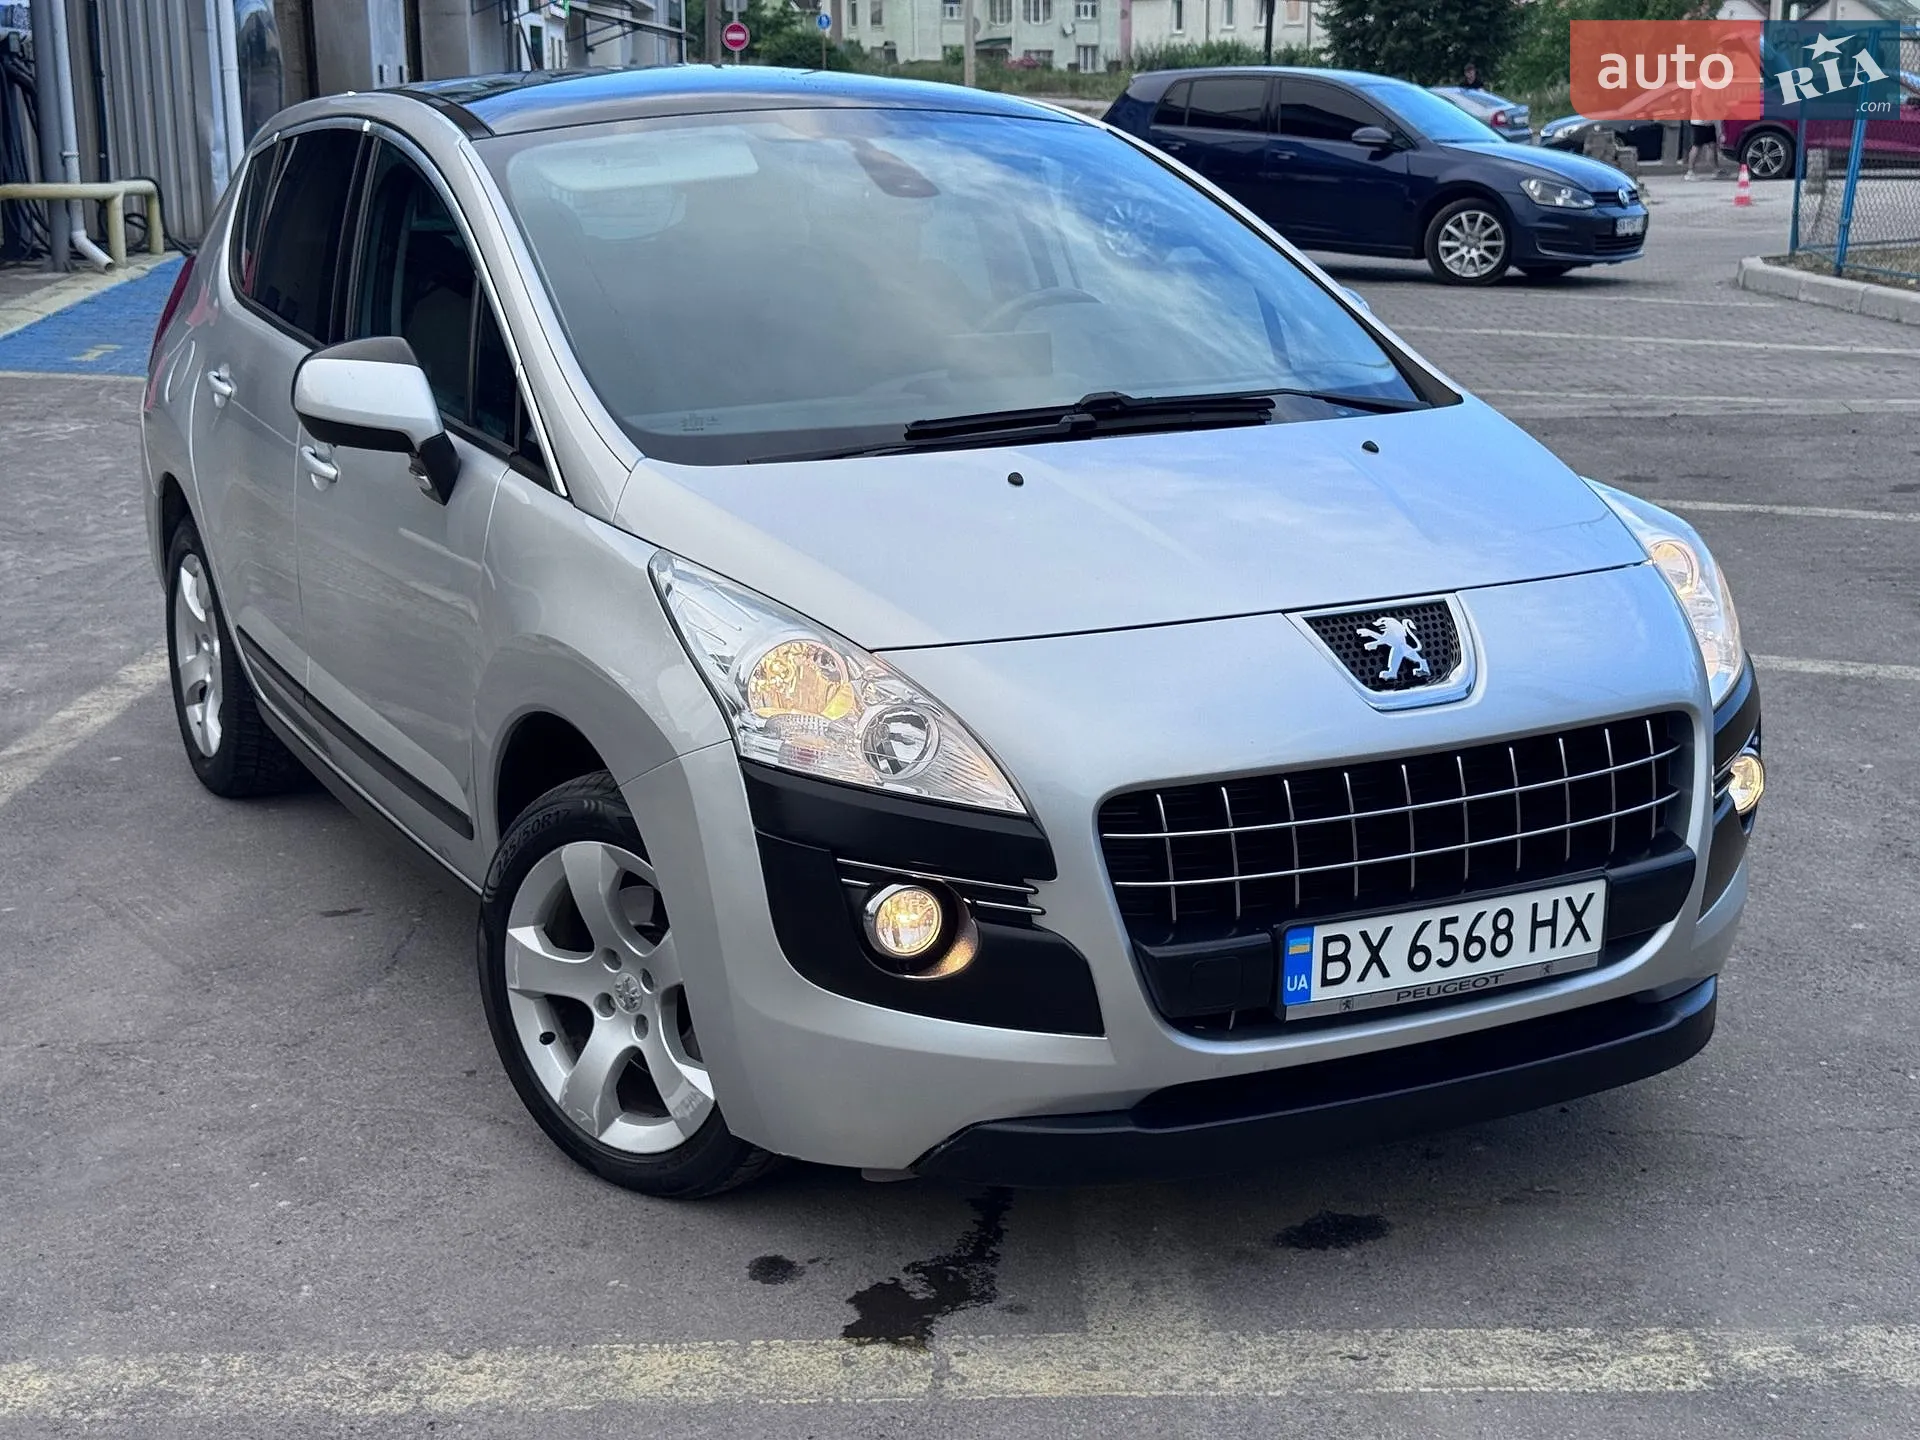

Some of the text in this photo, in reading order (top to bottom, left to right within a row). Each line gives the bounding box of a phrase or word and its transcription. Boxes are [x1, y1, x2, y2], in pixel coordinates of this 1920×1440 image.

[1320, 892, 1595, 988] BX 6568 HX
[1286, 975, 1308, 992] UA
[1396, 973, 1504, 1002] PEUGEOT
